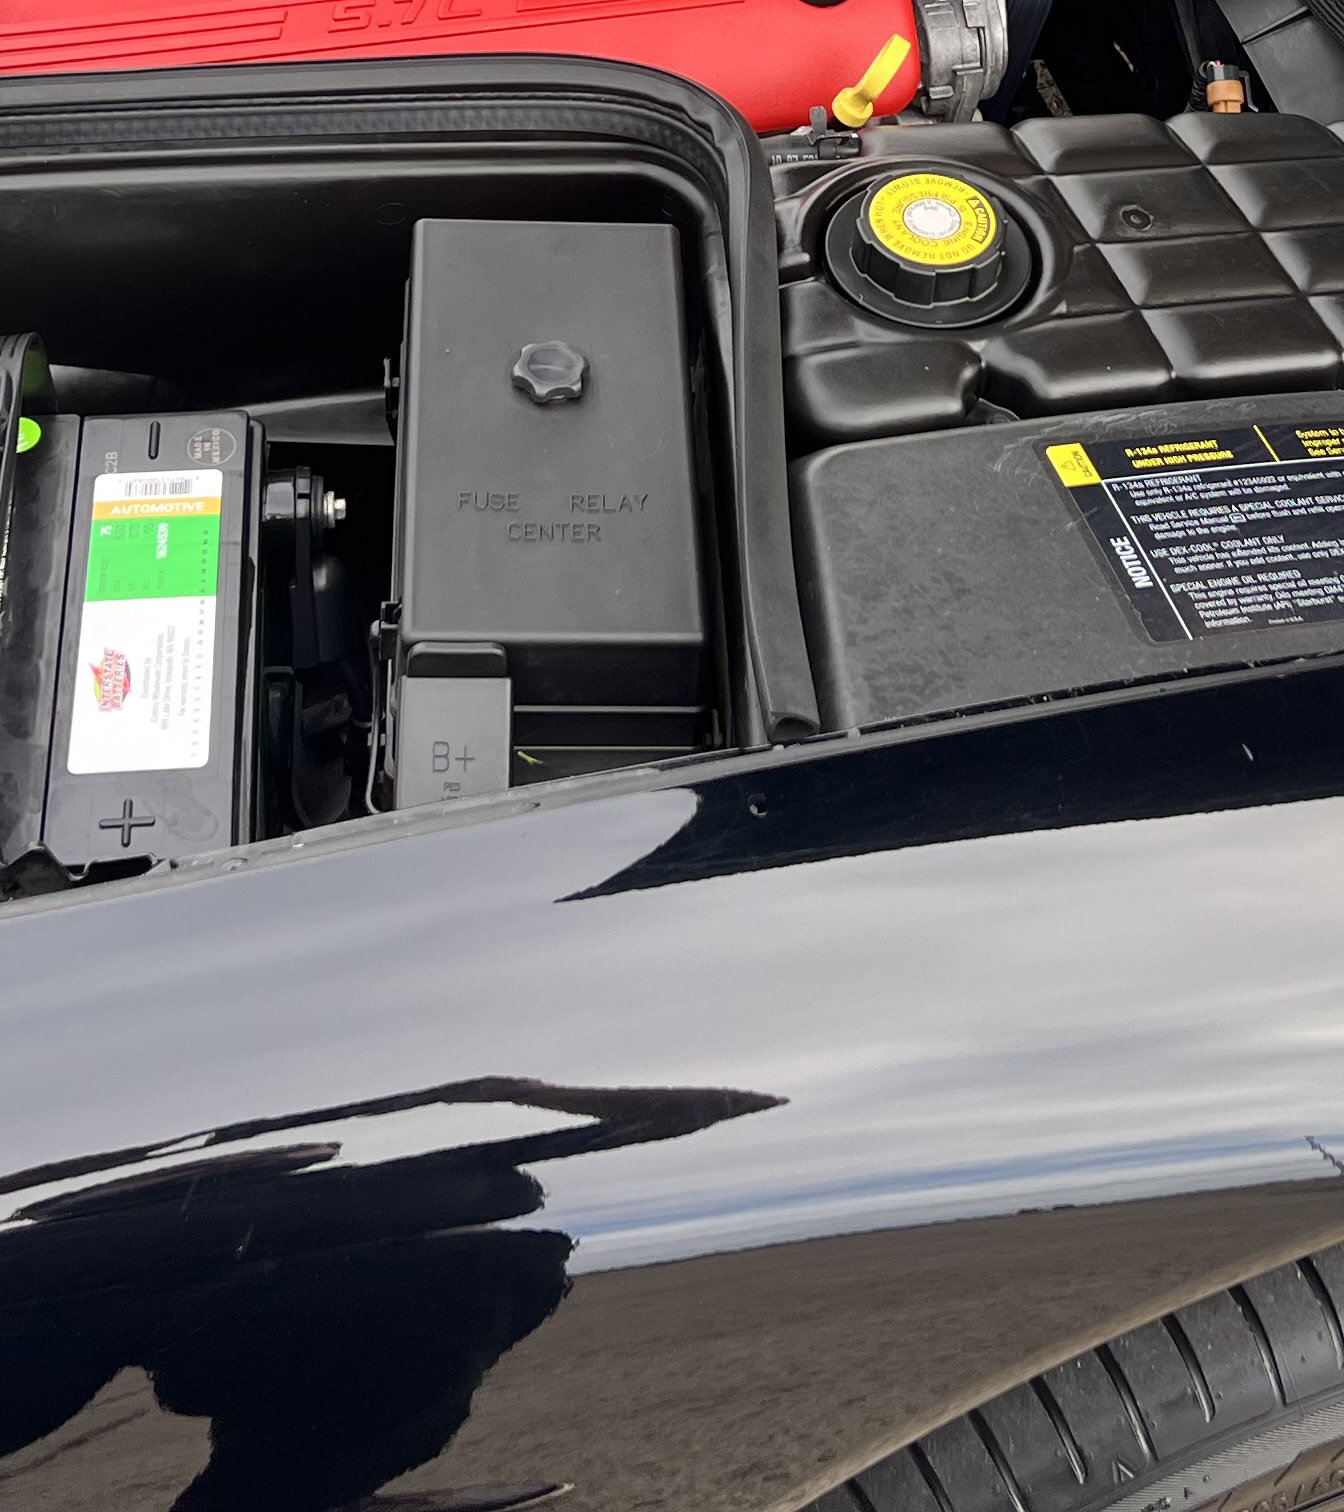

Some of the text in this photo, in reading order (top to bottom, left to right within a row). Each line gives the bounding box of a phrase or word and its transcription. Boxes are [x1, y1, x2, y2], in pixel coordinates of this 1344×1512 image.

[892, 219, 938, 246] COOLANT
[972, 206, 991, 244] CAUTION
[892, 239, 936, 259] REMOVE
[110, 501, 206, 515] AUTOMOTIVE
[457, 491, 649, 514] FUSE RELAY
[507, 522, 602, 543] CENTER
[1109, 536, 1154, 588] NOTICE
[98, 648, 114, 712] INTERSTATE
[111, 653, 125, 711] BATTERIES
[430, 740, 477, 774] B+
